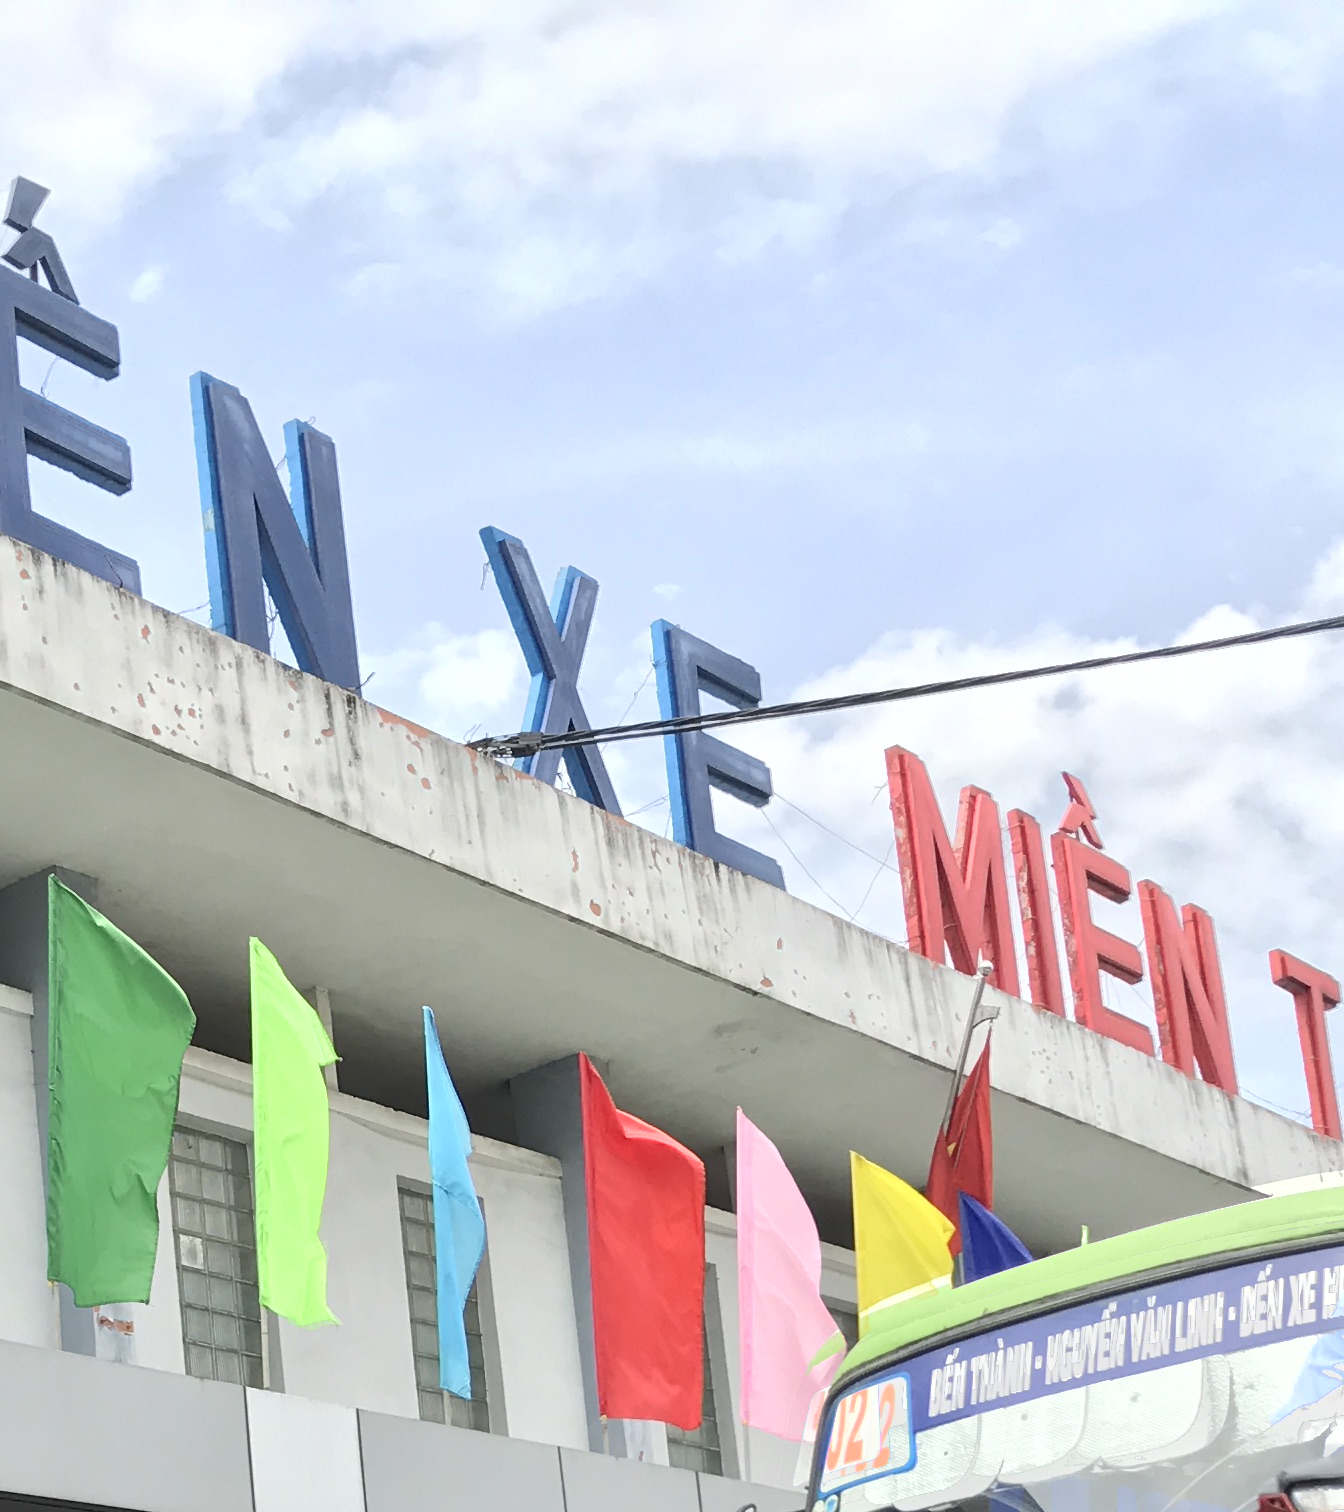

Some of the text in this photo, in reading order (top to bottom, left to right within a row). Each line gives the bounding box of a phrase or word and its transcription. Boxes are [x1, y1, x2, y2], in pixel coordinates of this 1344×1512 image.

[479, 525, 787, 892] XE
[884, 744, 1239, 1096] MIỀN
[1287, 1270, 1317, 1327] XE
